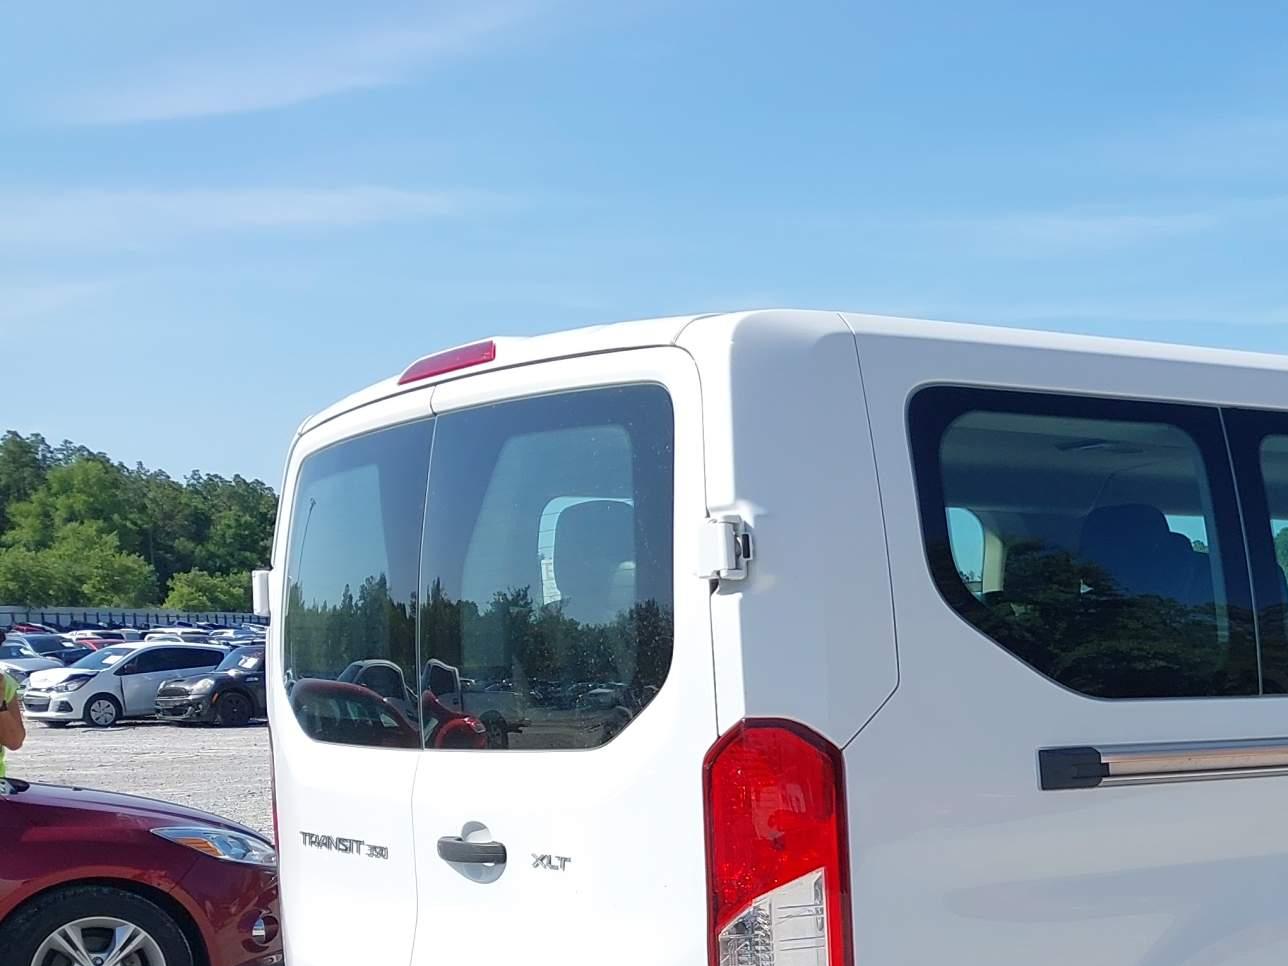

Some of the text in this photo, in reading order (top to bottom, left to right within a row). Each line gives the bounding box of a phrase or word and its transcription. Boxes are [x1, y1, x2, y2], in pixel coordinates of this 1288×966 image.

[299, 831, 389, 860] TRANSIT 350
[530, 852, 572, 872] XLT
